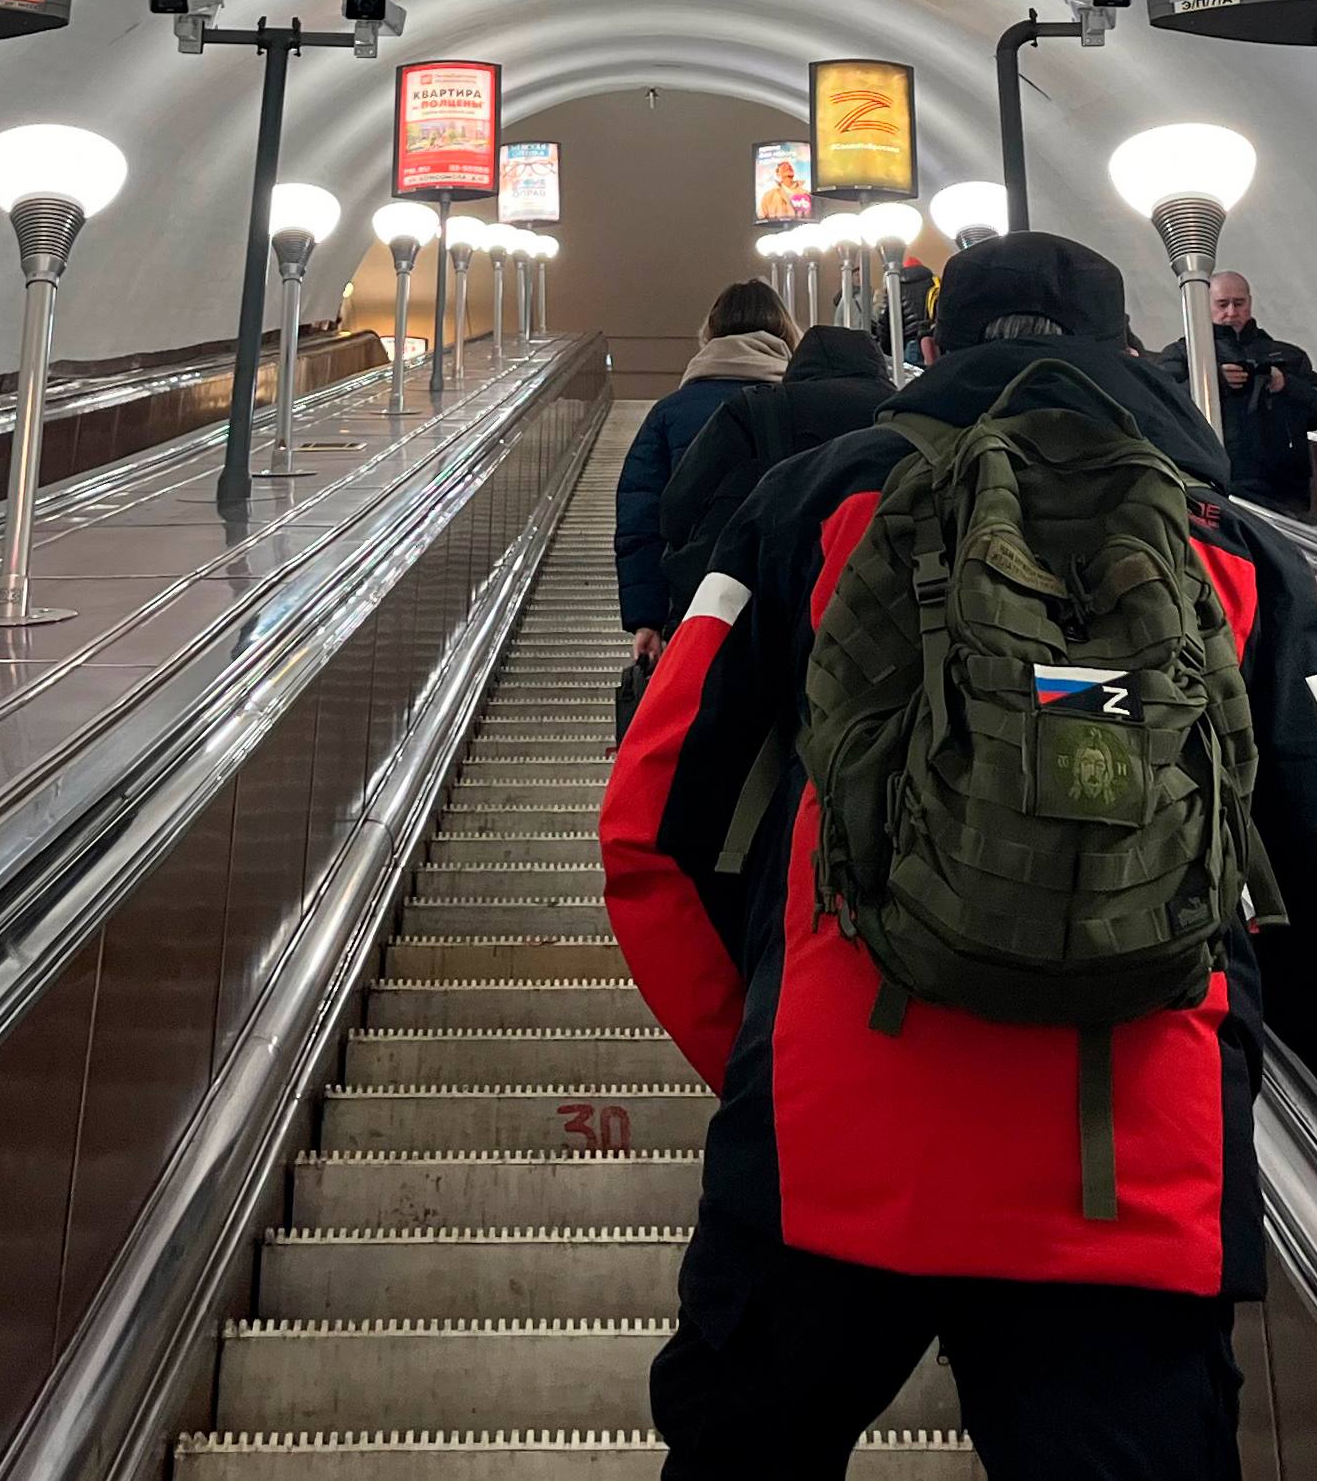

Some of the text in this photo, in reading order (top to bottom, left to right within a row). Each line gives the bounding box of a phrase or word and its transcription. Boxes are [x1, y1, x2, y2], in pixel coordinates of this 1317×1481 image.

[413, 88, 482, 100] КВАРТИРА
[421, 99, 483, 109] ПОЛЦЕНЫ
[1101, 684, 1131, 716] Z
[556, 1103, 632, 1157] 30
